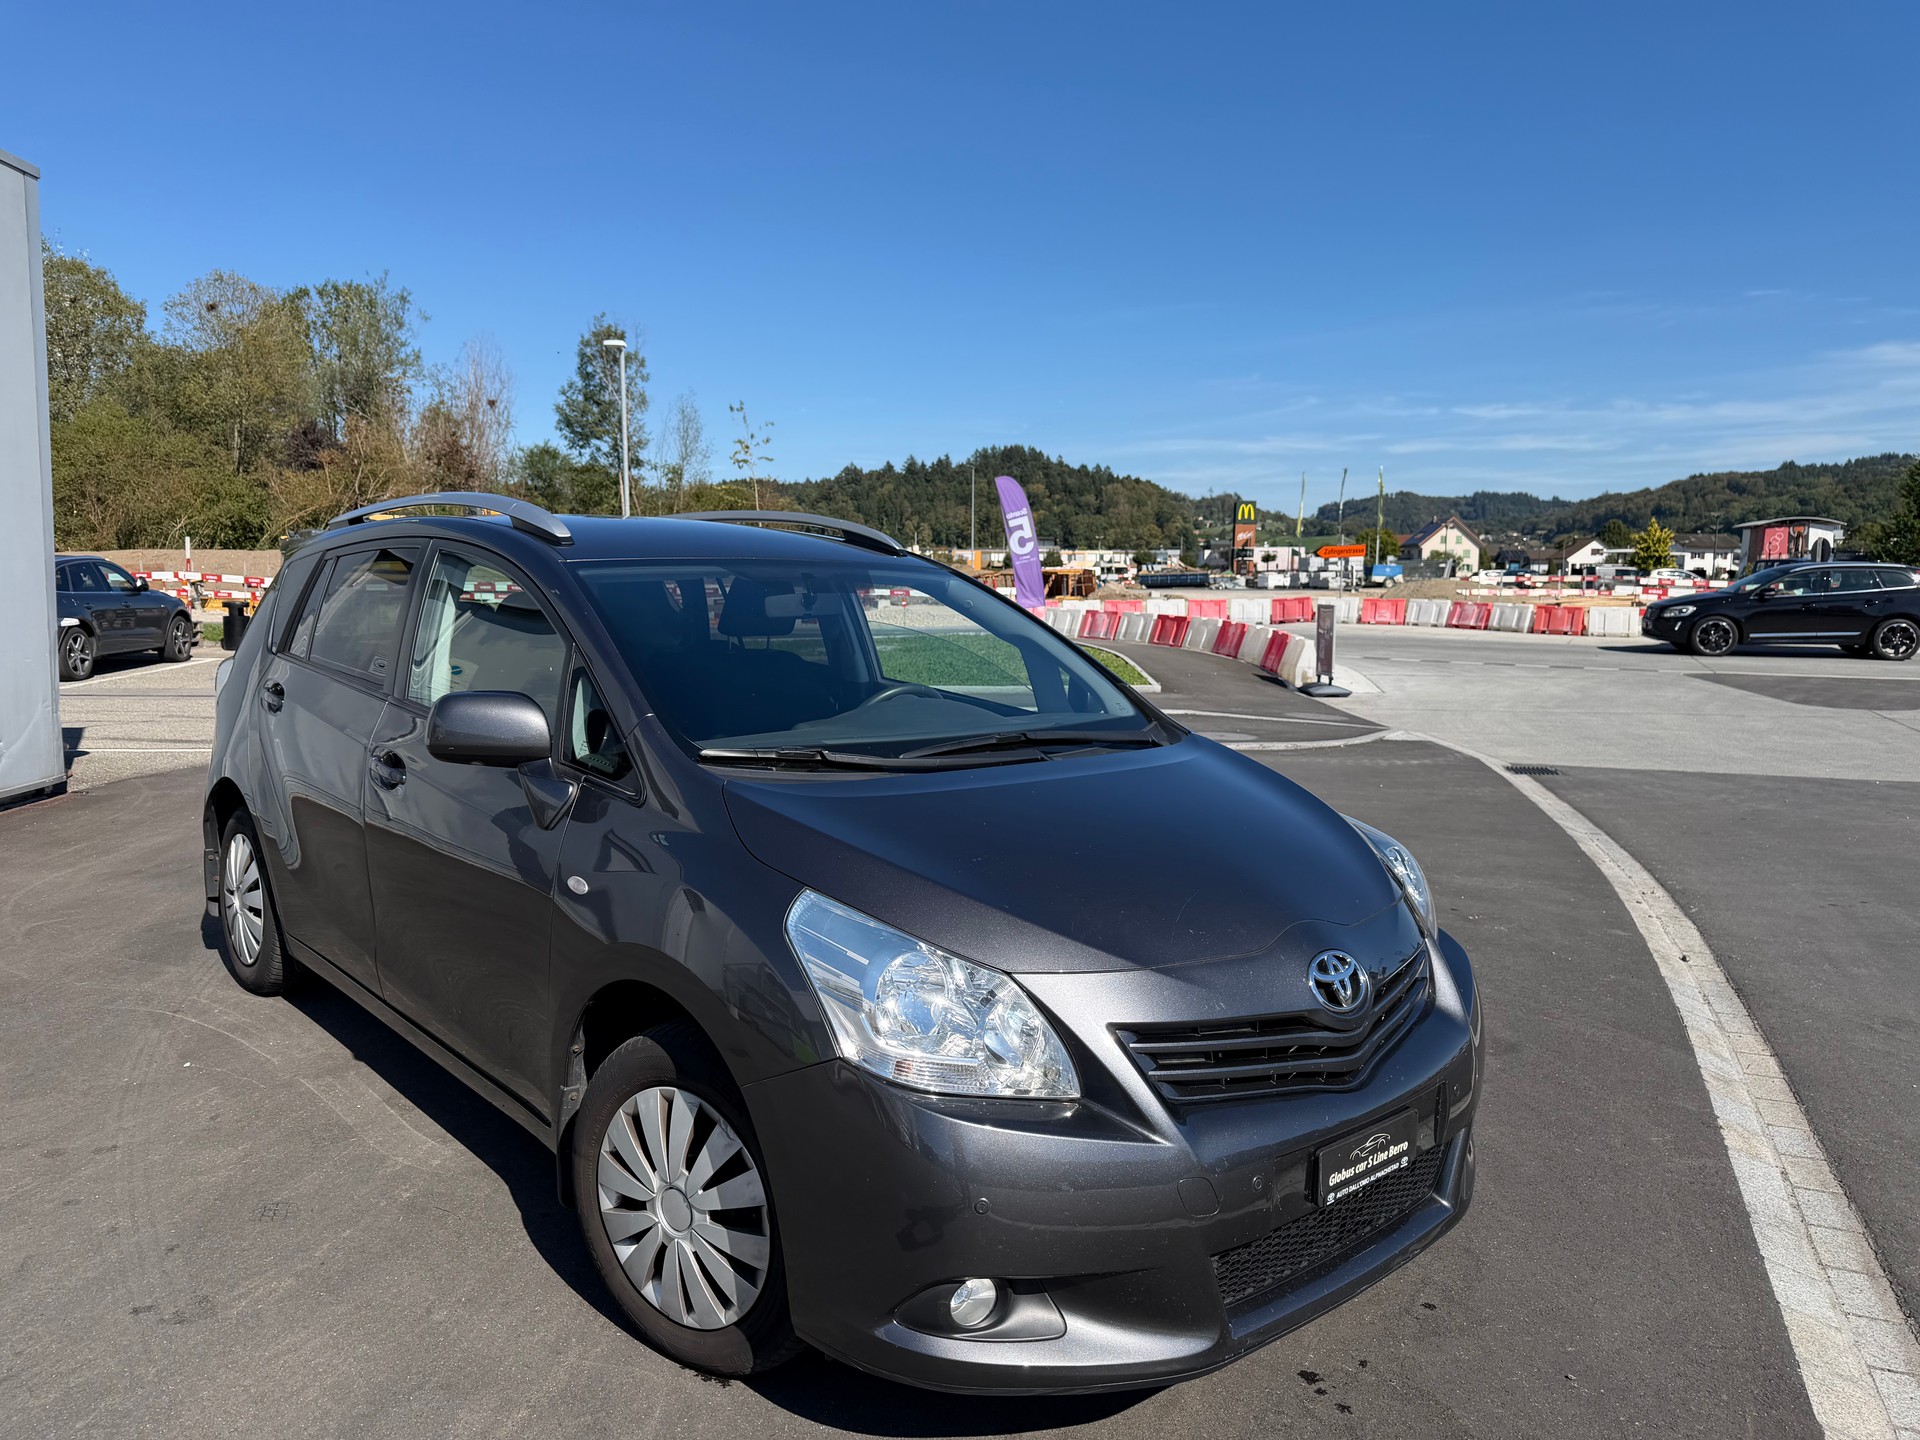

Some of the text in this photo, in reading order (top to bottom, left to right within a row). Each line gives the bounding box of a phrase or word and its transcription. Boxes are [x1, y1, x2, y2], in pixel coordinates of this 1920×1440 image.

[1329, 1141, 1409, 1187] Globus car S Line Berro
